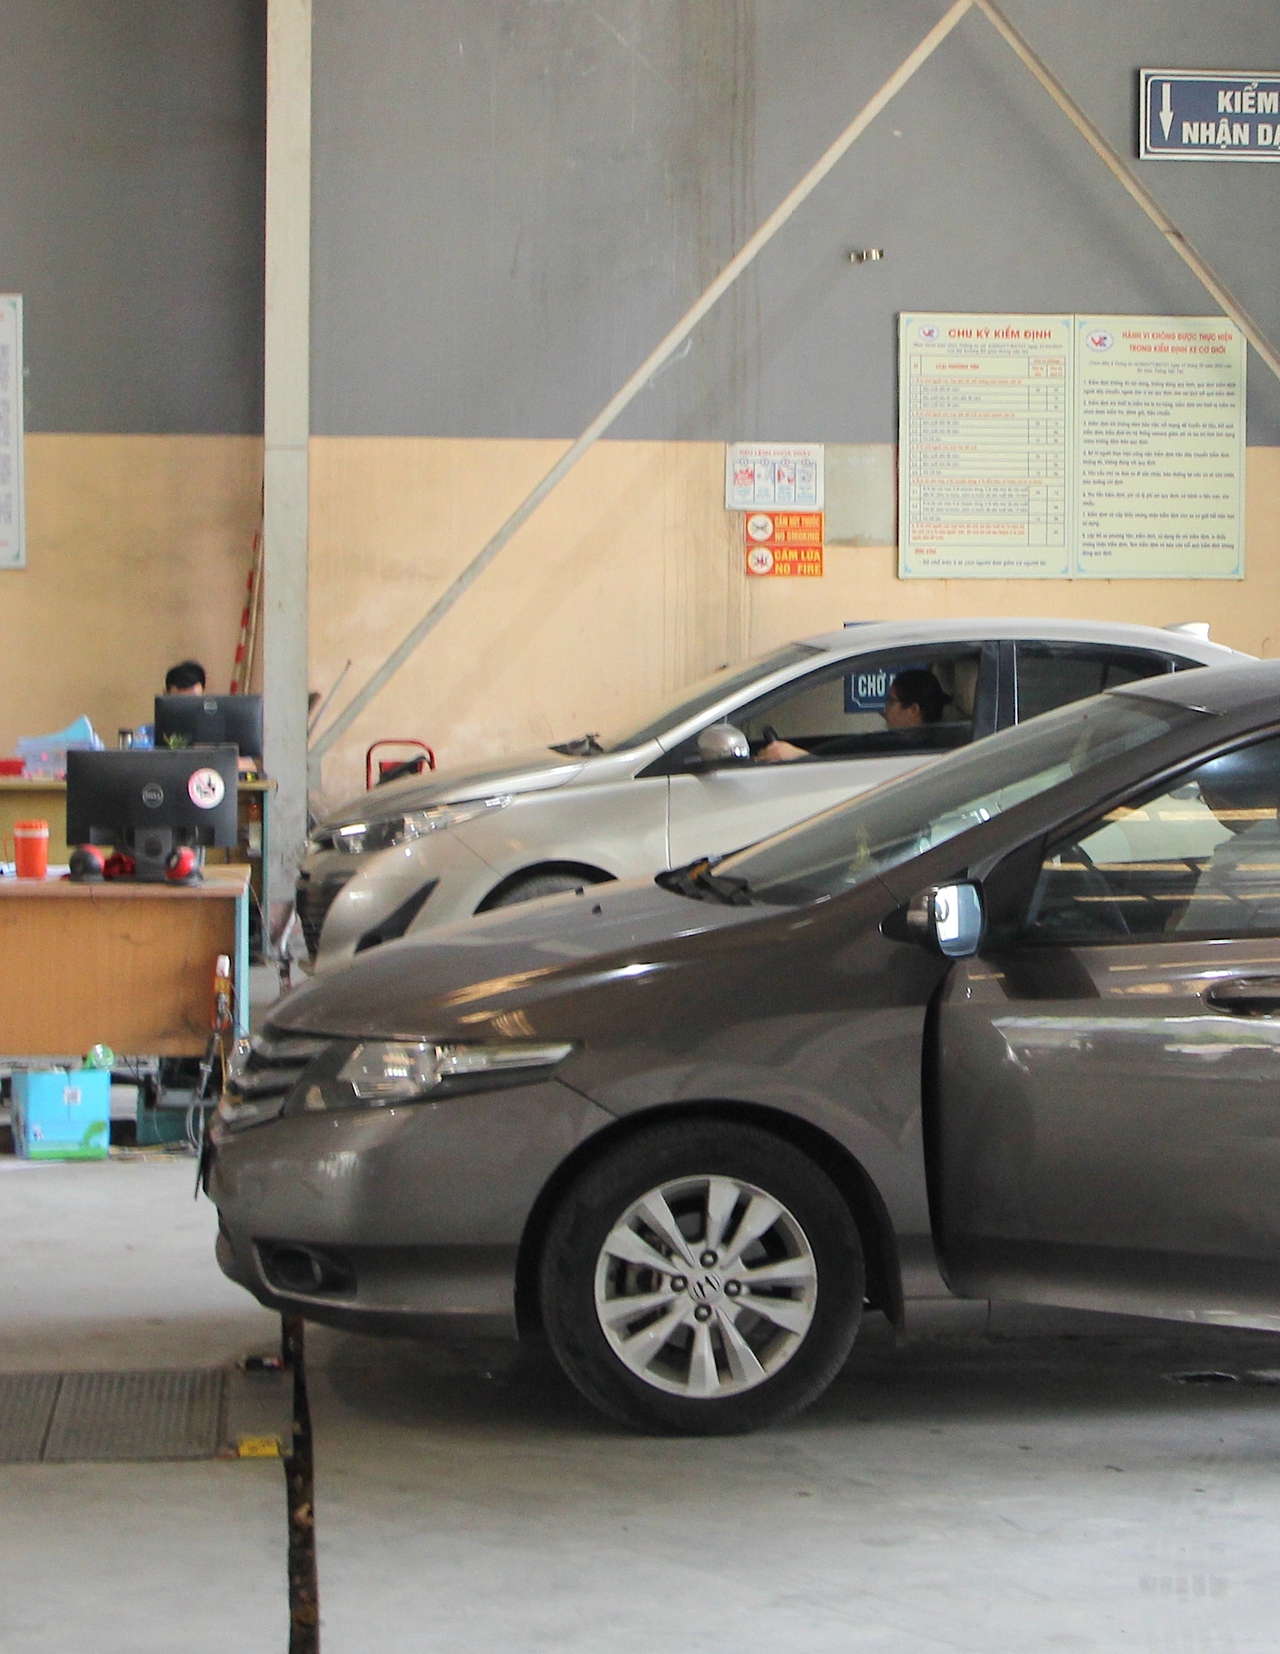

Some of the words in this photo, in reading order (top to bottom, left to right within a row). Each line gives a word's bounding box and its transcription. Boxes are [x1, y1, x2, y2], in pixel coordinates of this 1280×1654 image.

[1217, 82, 1279, 114] KIỂM
[1182, 118, 1250, 149] NHẬN
[948, 328, 973, 339] CHU
[994, 325, 1020, 339] KIỂM
[1024, 329, 1052, 341] ĐỊNH
[1122, 330, 1142, 340] HÀNH
[1151, 331, 1176, 341] KHÔNG
[1177, 332, 1197, 342] ĐƯỢC
[1217, 332, 1233, 342] HIỆN
[1129, 345, 1151, 353] TRONG
[1153, 342, 1170, 354] KIỂM
[1171, 345, 1188, 355] ĐỊNH
[1189, 346, 1198, 354] XE
[775, 563, 791, 575] NO
[797, 563, 820, 575] FIRE
[858, 668, 887, 697] CHỜ
